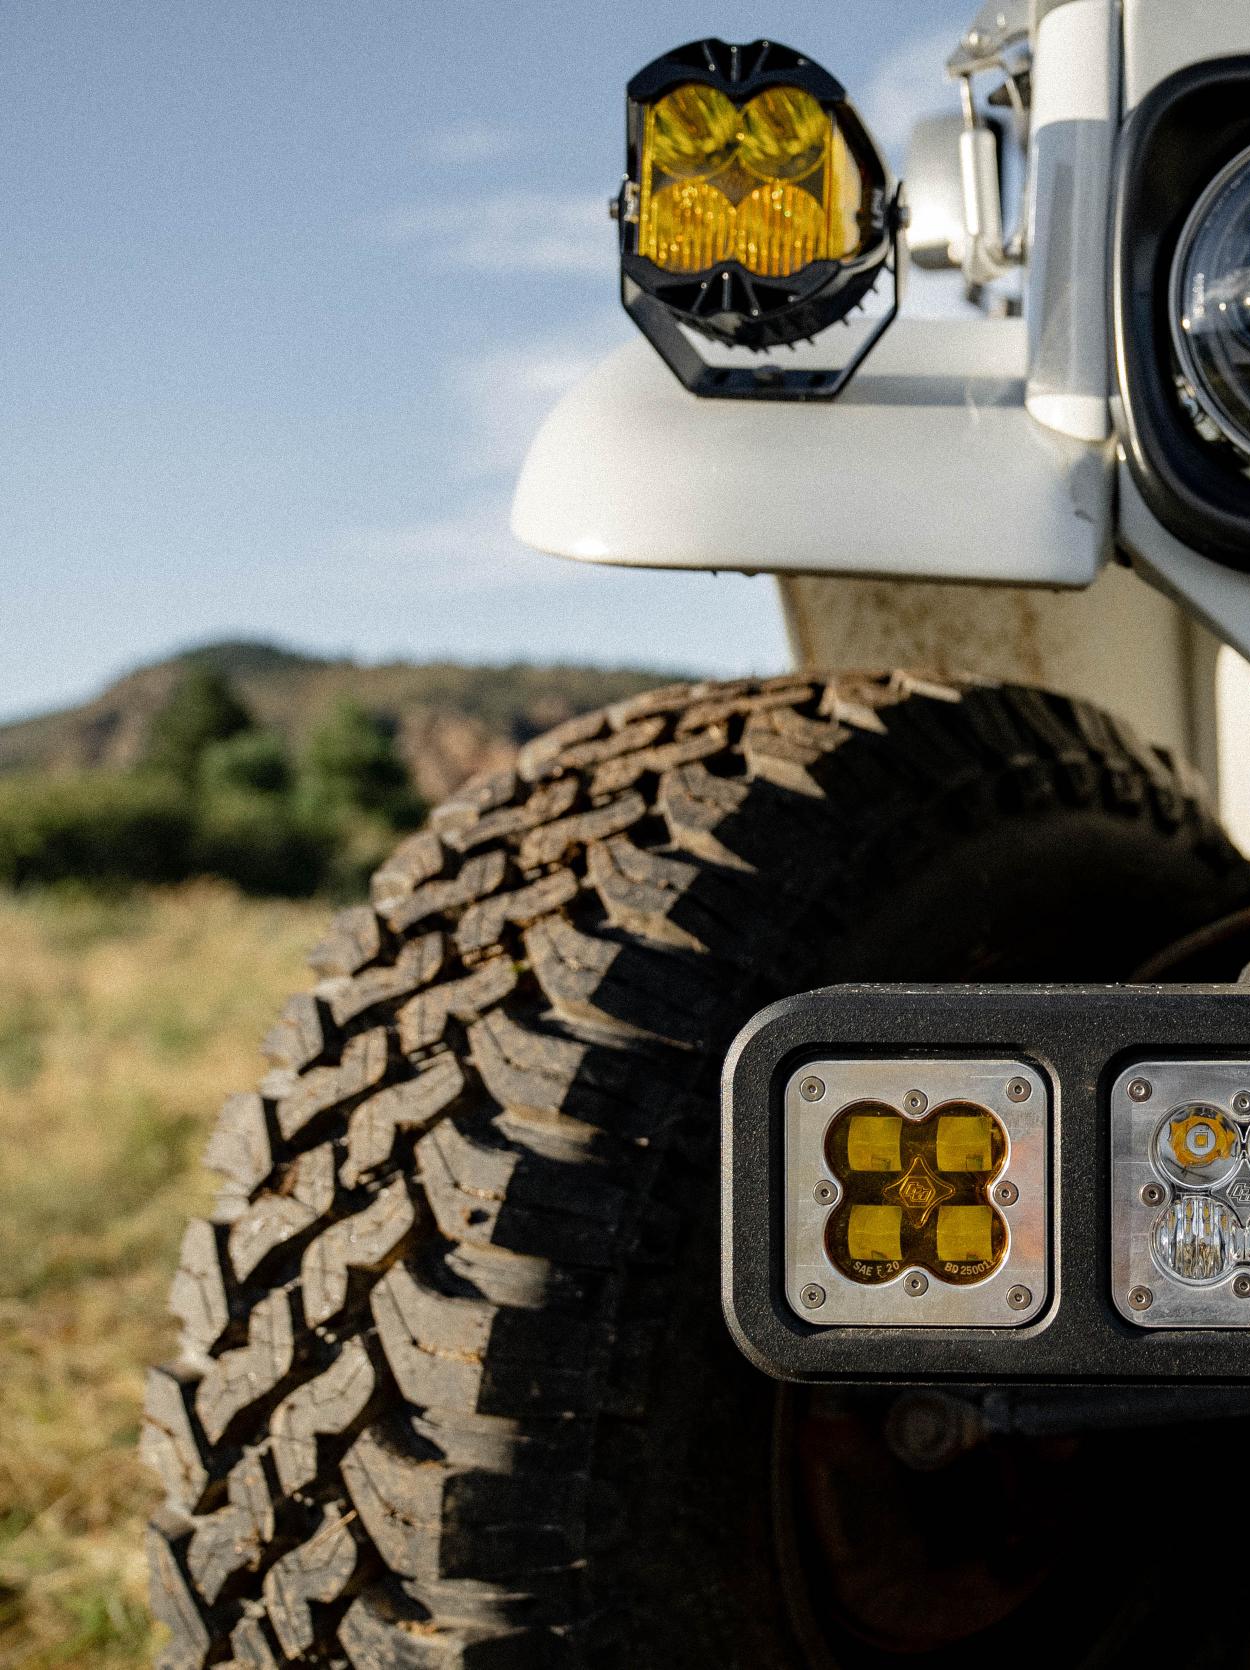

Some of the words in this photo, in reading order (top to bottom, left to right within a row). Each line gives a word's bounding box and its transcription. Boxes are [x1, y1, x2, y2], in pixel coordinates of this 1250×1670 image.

[853, 1261, 873, 1276] SAE
[886, 1261, 900, 1273] 20
[944, 1262, 959, 1274] BD
